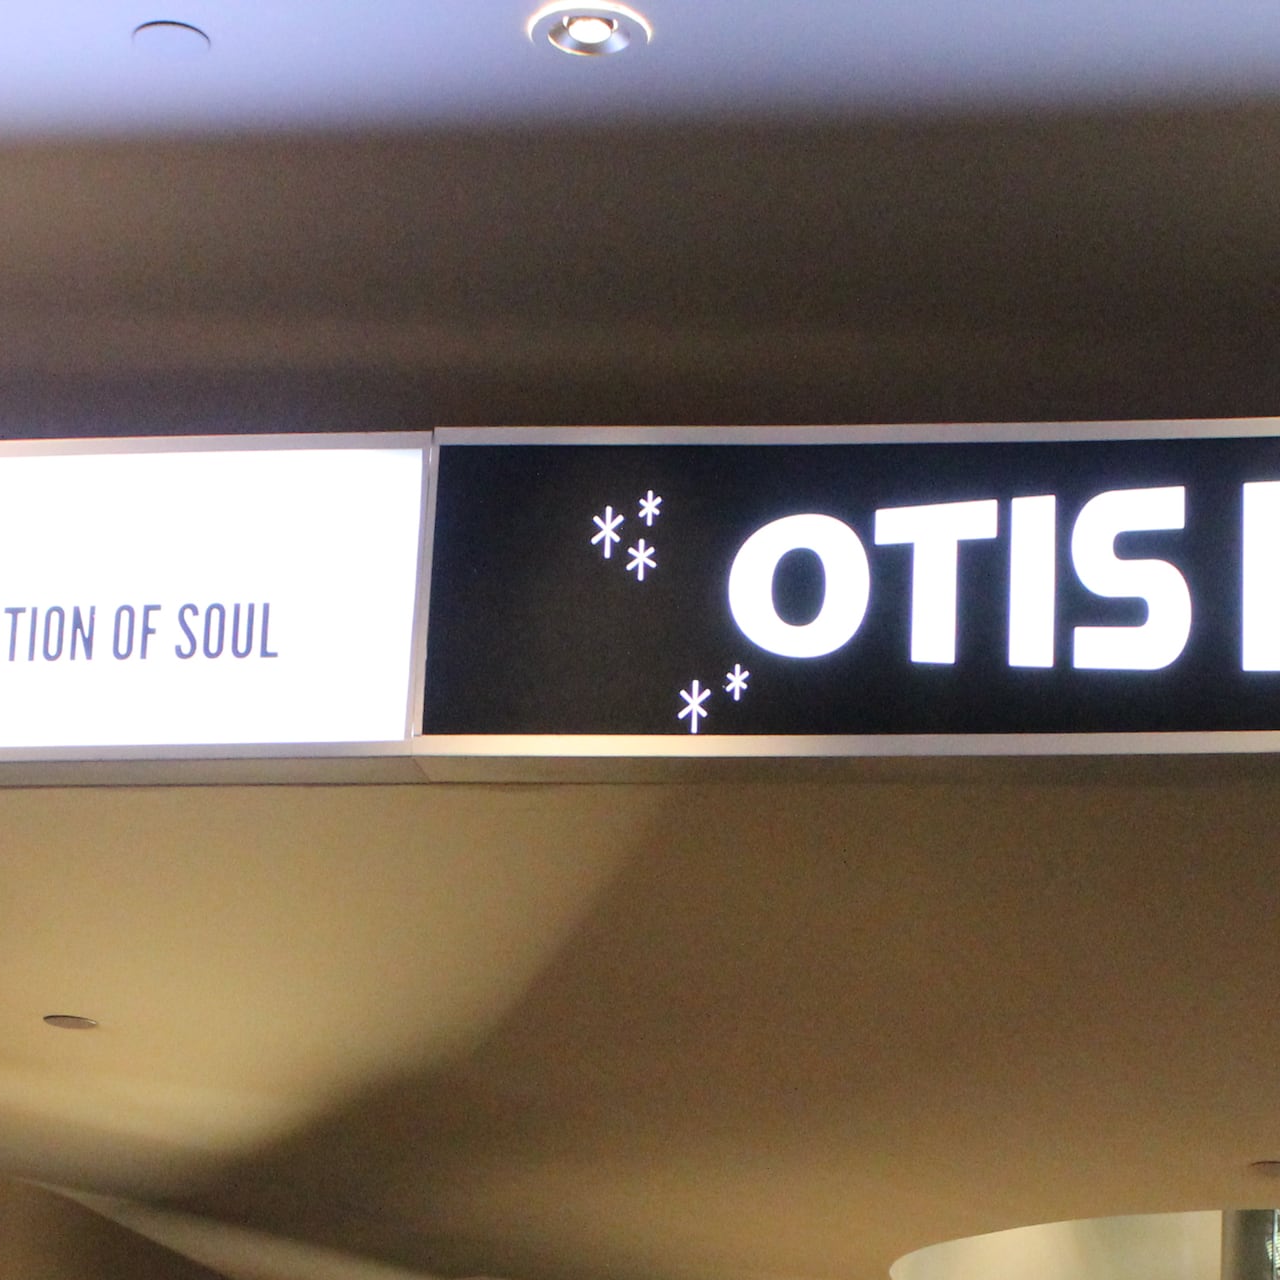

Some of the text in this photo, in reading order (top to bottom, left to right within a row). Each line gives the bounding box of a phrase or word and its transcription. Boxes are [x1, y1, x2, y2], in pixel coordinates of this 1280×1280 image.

[112, 604, 163, 661] OF
[175, 602, 279, 660] SOUL
[726, 485, 1189, 669] OTIS
